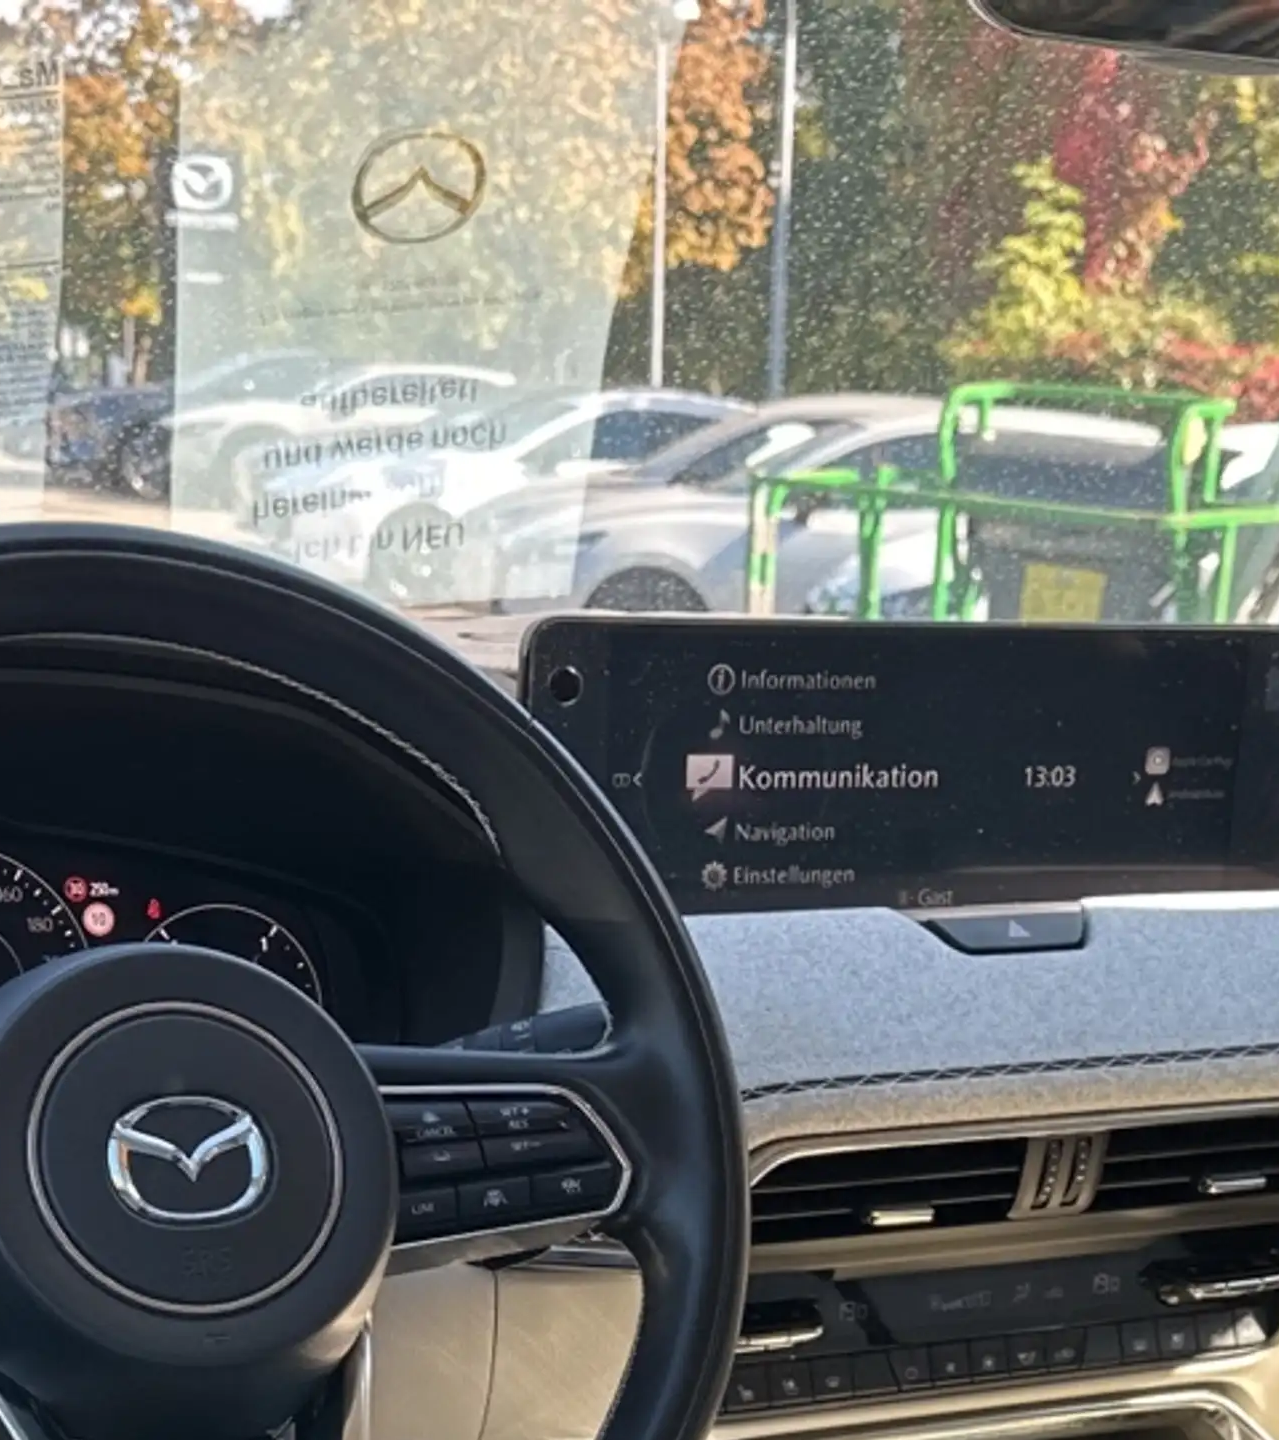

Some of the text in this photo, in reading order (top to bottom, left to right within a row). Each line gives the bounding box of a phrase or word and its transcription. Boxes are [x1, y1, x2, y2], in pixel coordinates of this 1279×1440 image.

[741, 669, 877, 690] Informationen
[738, 716, 863, 740] Unterhaltung
[738, 763, 940, 791] Kommunikation
[1024, 765, 1076, 788] 13:03
[734, 822, 836, 847] Navigation
[733, 864, 855, 888] Einstellungen
[26, 917, 53, 933] 180
